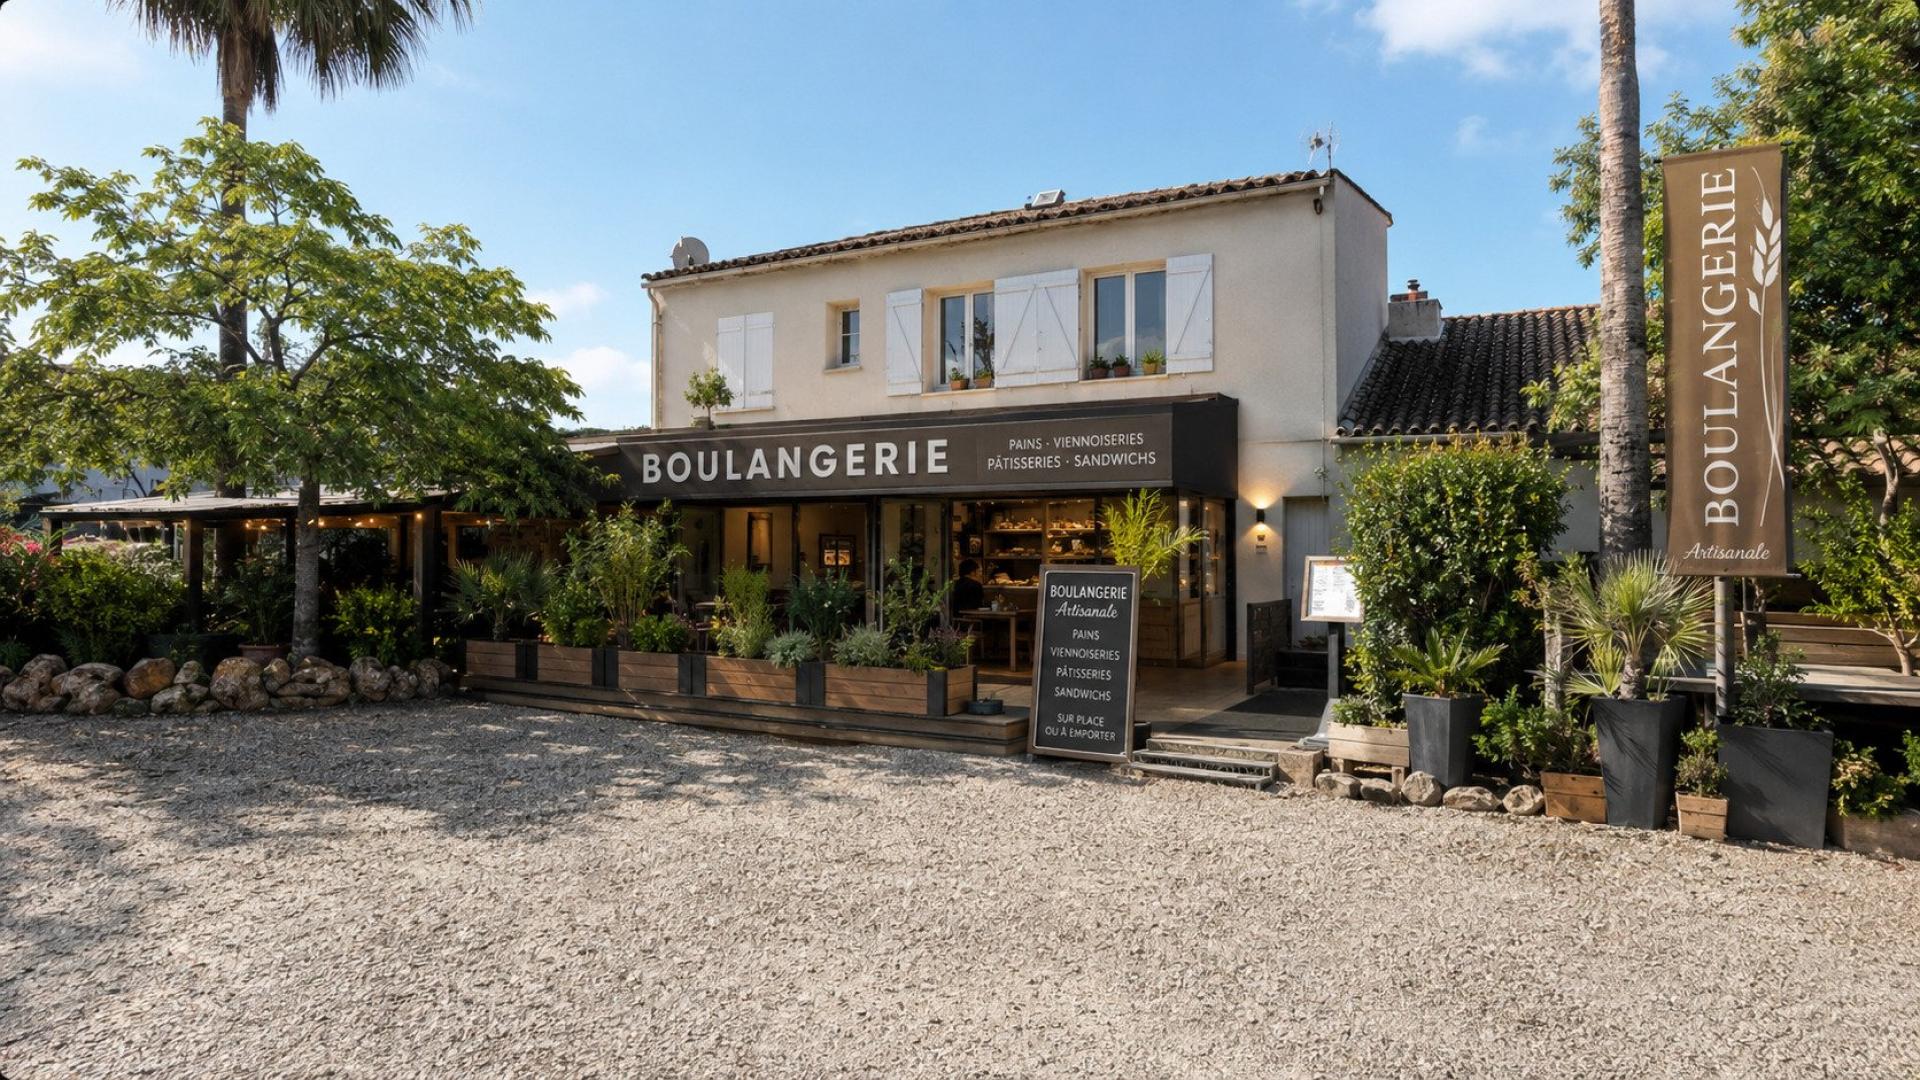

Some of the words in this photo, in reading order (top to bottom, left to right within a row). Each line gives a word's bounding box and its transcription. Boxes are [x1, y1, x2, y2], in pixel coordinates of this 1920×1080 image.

[1701, 168, 1738, 527] BOULANGERIE
[1009, 438, 1043, 450] PAINS
[1053, 433, 1144, 448] VIENNOISERIES
[642, 439, 949, 484] BOULANGERIE
[987, 454, 1061, 470] PÂTISSERIES
[1074, 452, 1156, 467] SANDWICHS
[1683, 542, 1770, 560] Artisanale
[1050, 585, 1127, 599] BOULANGERIE
[1055, 601, 1118, 618] Artisanale
[1072, 629, 1100, 640] PAINS
[1050, 647, 1120, 661] VIENNOISERIES
[1056, 665, 1112, 680] PÂTISSERIES
[1054, 686, 1112, 701] SANDWICHS
[1057, 713, 1074, 723] SUR
[1076, 714, 1104, 727] PLACE
[1045, 726, 1059, 736] OU
[1069, 728, 1116, 741] EMPORTER
